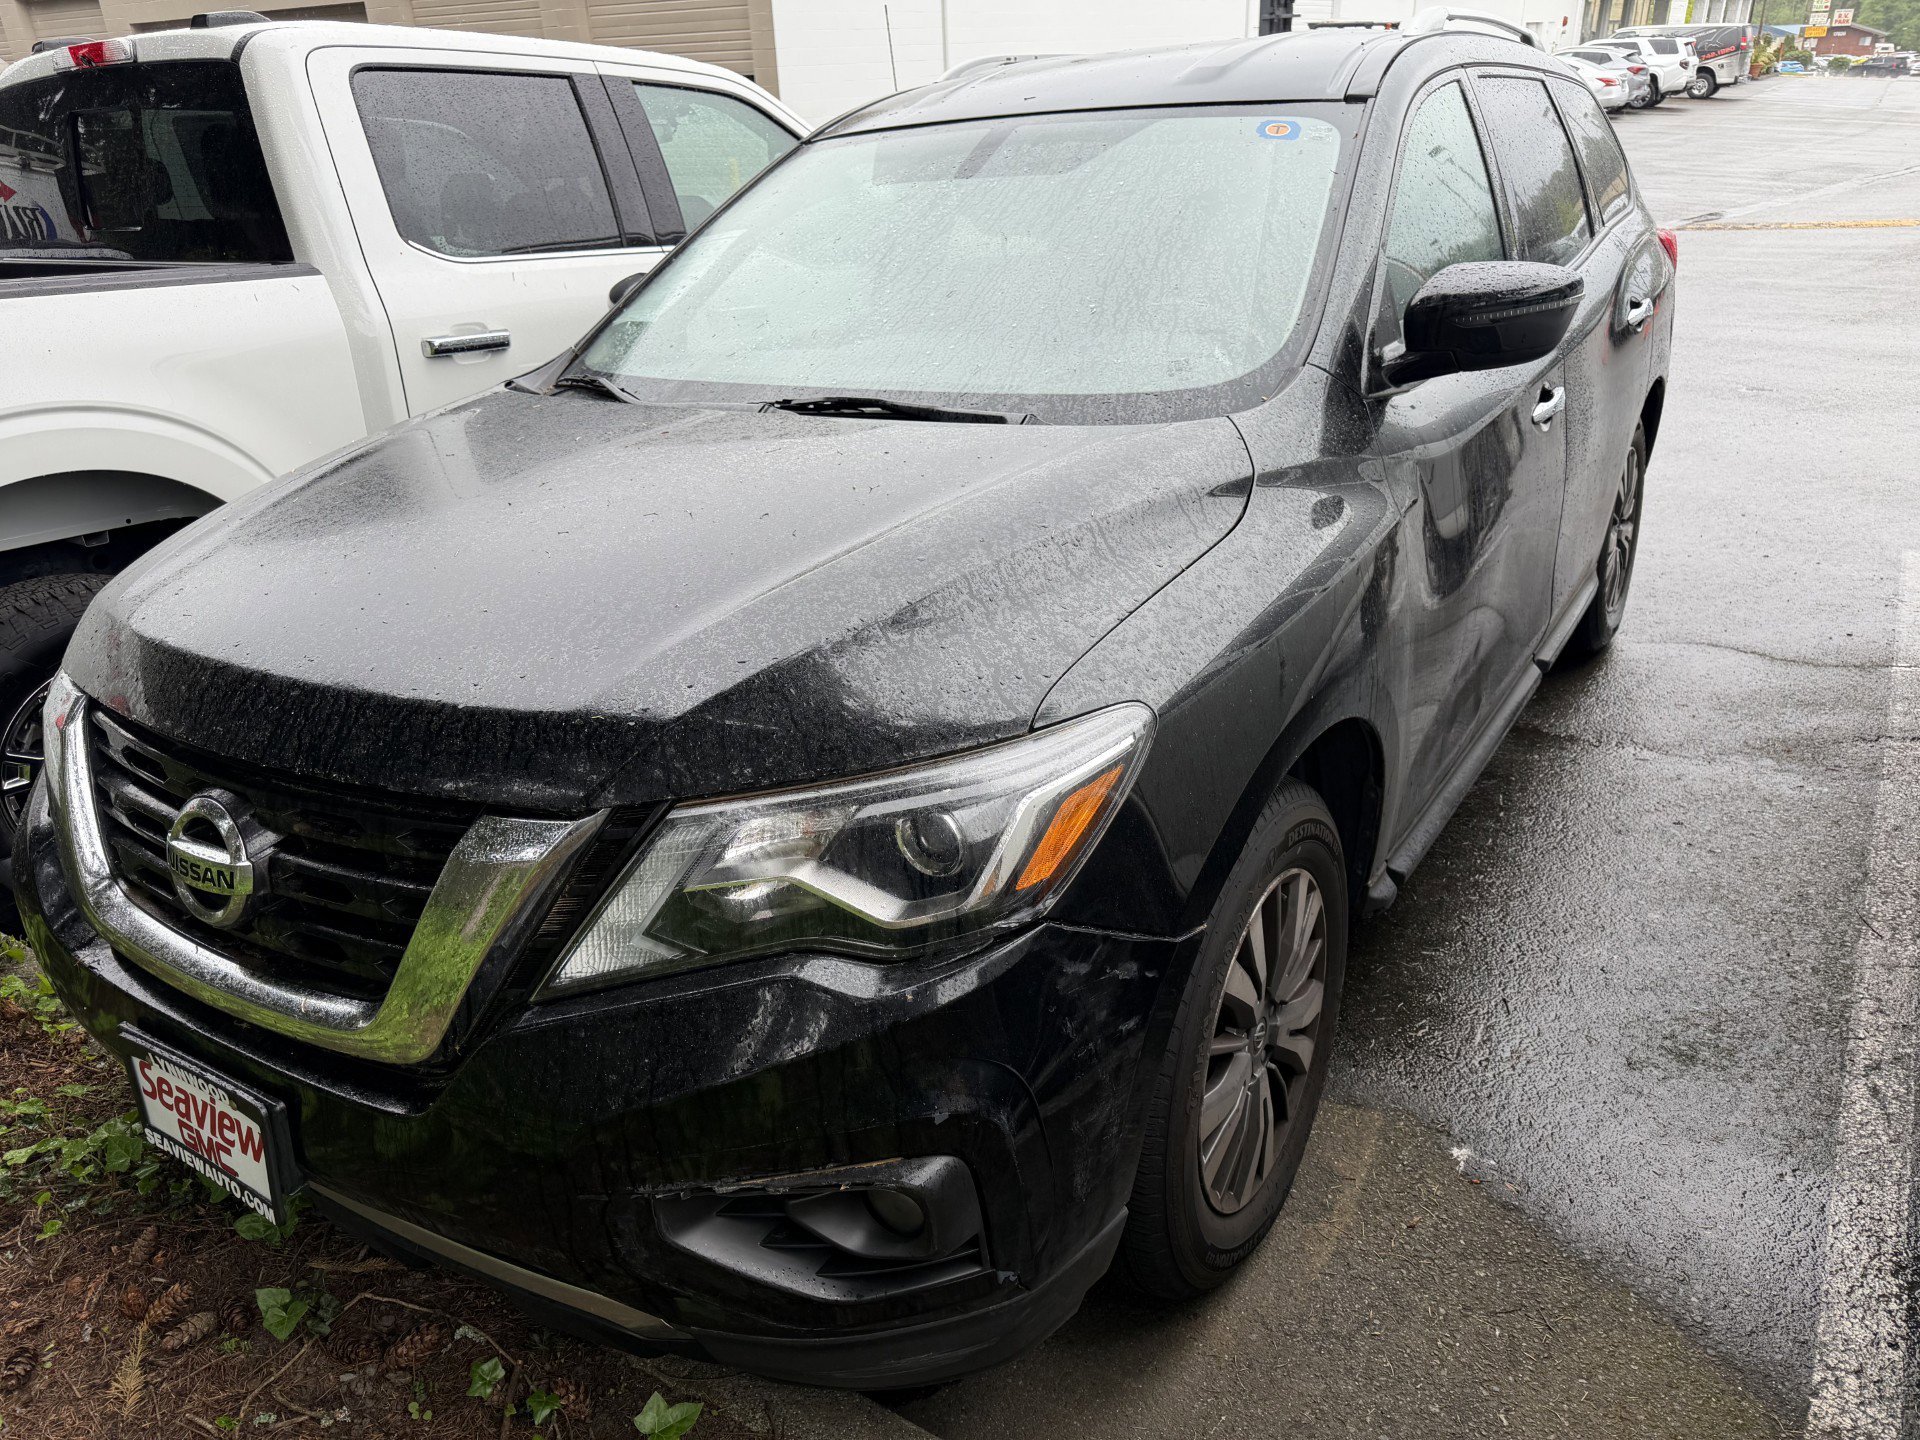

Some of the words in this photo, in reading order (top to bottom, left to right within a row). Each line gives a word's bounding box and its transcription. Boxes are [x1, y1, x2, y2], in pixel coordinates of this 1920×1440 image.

[1288, 821, 1334, 848] DESTINATION
[168, 850, 235, 890] NISSAN
[148, 1052, 230, 1106] LYNNWOOD
[138, 1059, 265, 1164] Seaview
[144, 1127, 276, 1226] SEAVIEWAUTO.COM
[177, 1118, 240, 1178] GMC
